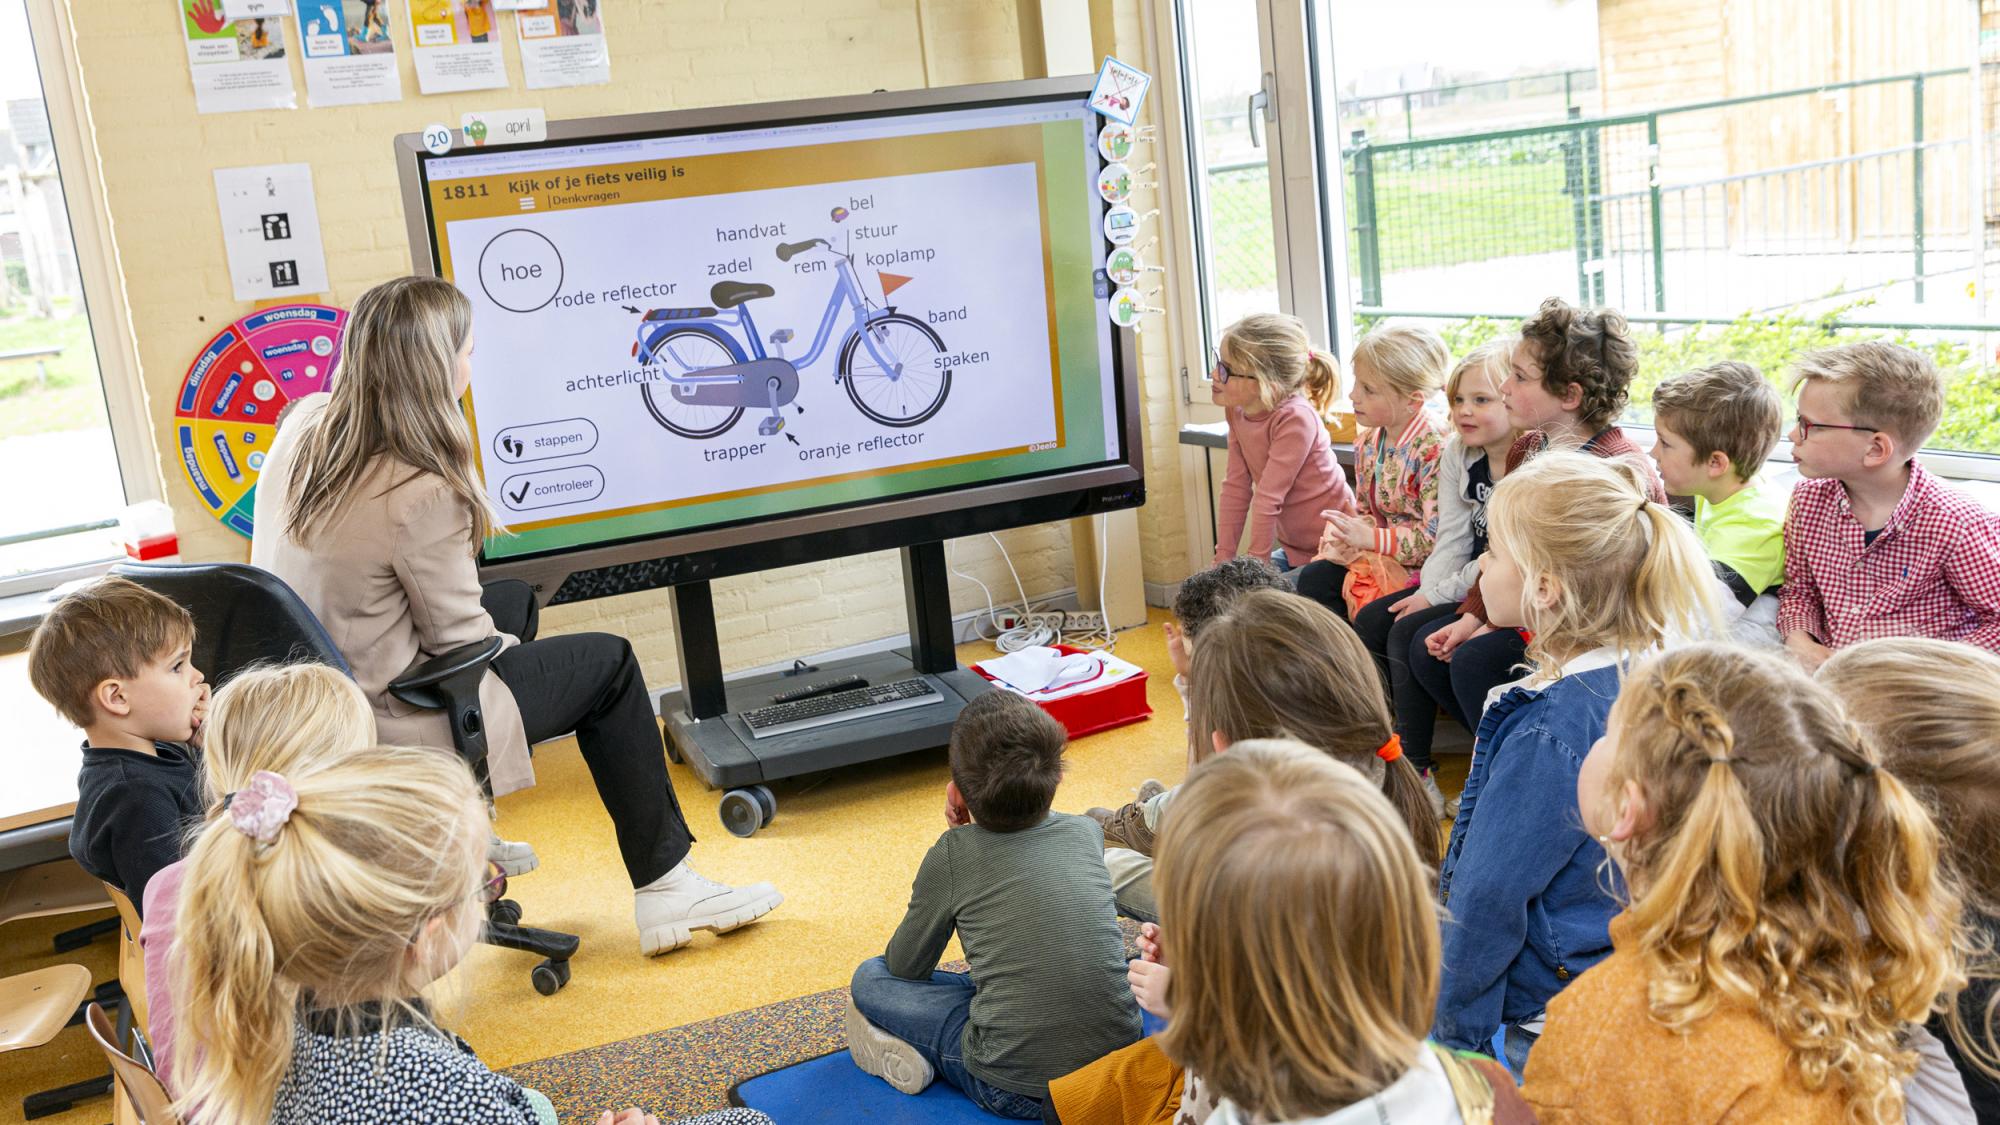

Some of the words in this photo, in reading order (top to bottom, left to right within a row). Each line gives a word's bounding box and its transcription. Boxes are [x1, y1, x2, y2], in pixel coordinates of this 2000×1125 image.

[505, 118, 531, 135] april
[427, 130, 449, 148] 20
[443, 183, 490, 200] 1811
[508, 178, 540, 195] Kijk
[545, 176, 560, 190] of
[565, 174, 582, 192] je
[585, 171, 620, 186] fiets
[625, 166, 667, 183] veilig
[672, 165, 685, 178] is
[553, 190, 620, 206] Denkvragen
[849, 195, 874, 211] bel
[716, 222, 787, 242] handvat
[855, 223, 899, 240] stuur
[866, 246, 936, 267] koplamp
[501, 263, 543, 281] hoe
[708, 257, 753, 276] zadel
[794, 260, 827, 274] rem
[555, 290, 595, 308] rode
[602, 282, 677, 302] reflector
[264, 309, 317, 323] woensdag
[929, 306, 968, 324] band
[265, 341, 308, 357] woensdag
[189, 350, 217, 387] dinsdag
[934, 350, 990, 372] spaken
[566, 367, 661, 392] achterlicht
[217, 379, 238, 409] dinsdag
[534, 431, 583, 449] stappen
[799, 442, 851, 464] oranje
[857, 430, 925, 454] reflector
[703, 441, 767, 465] trapper
[184, 446, 208, 491] maandag
[534, 477, 594, 497] controleer
